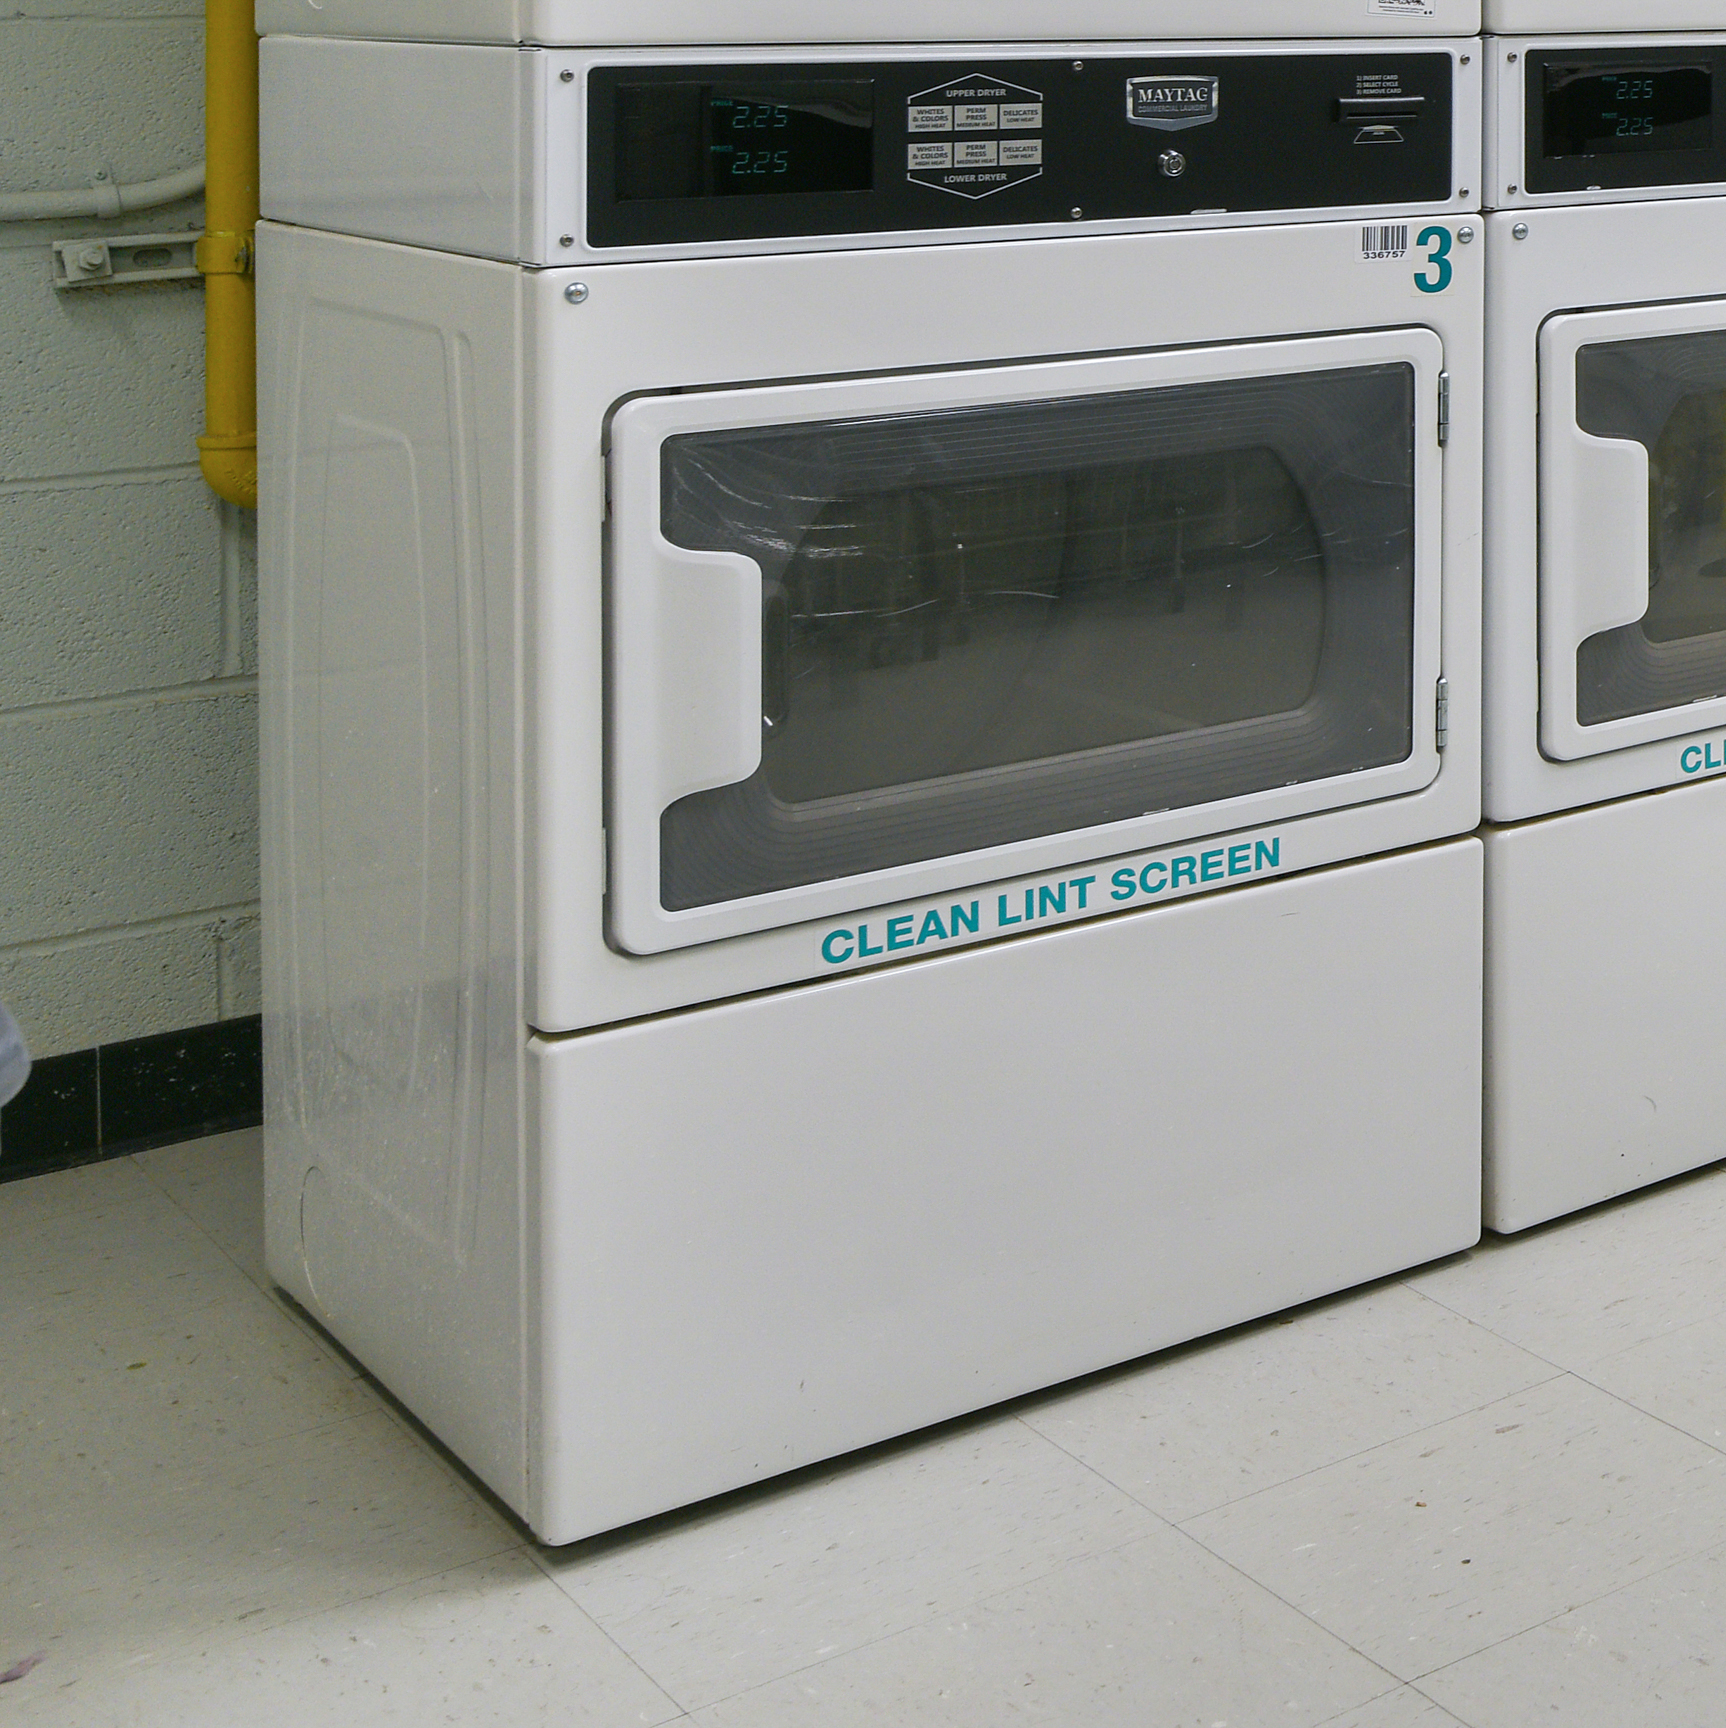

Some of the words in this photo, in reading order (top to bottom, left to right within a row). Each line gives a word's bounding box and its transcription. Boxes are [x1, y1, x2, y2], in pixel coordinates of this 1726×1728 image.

[1138, 87, 1208, 104] MAYTAG
[1616, 80, 1653, 100] 2.25
[732, 105, 789, 129] 2.25
[1616, 117, 1653, 137] 2.25
[732, 151, 789, 174] 2.25
[1363, 251, 1405, 259] 336757
[1414, 226, 1452, 293] 3
[821, 899, 980, 965] CLEAN
[998, 874, 1097, 928] LINT
[1110, 836, 1281, 902] SCREEN
